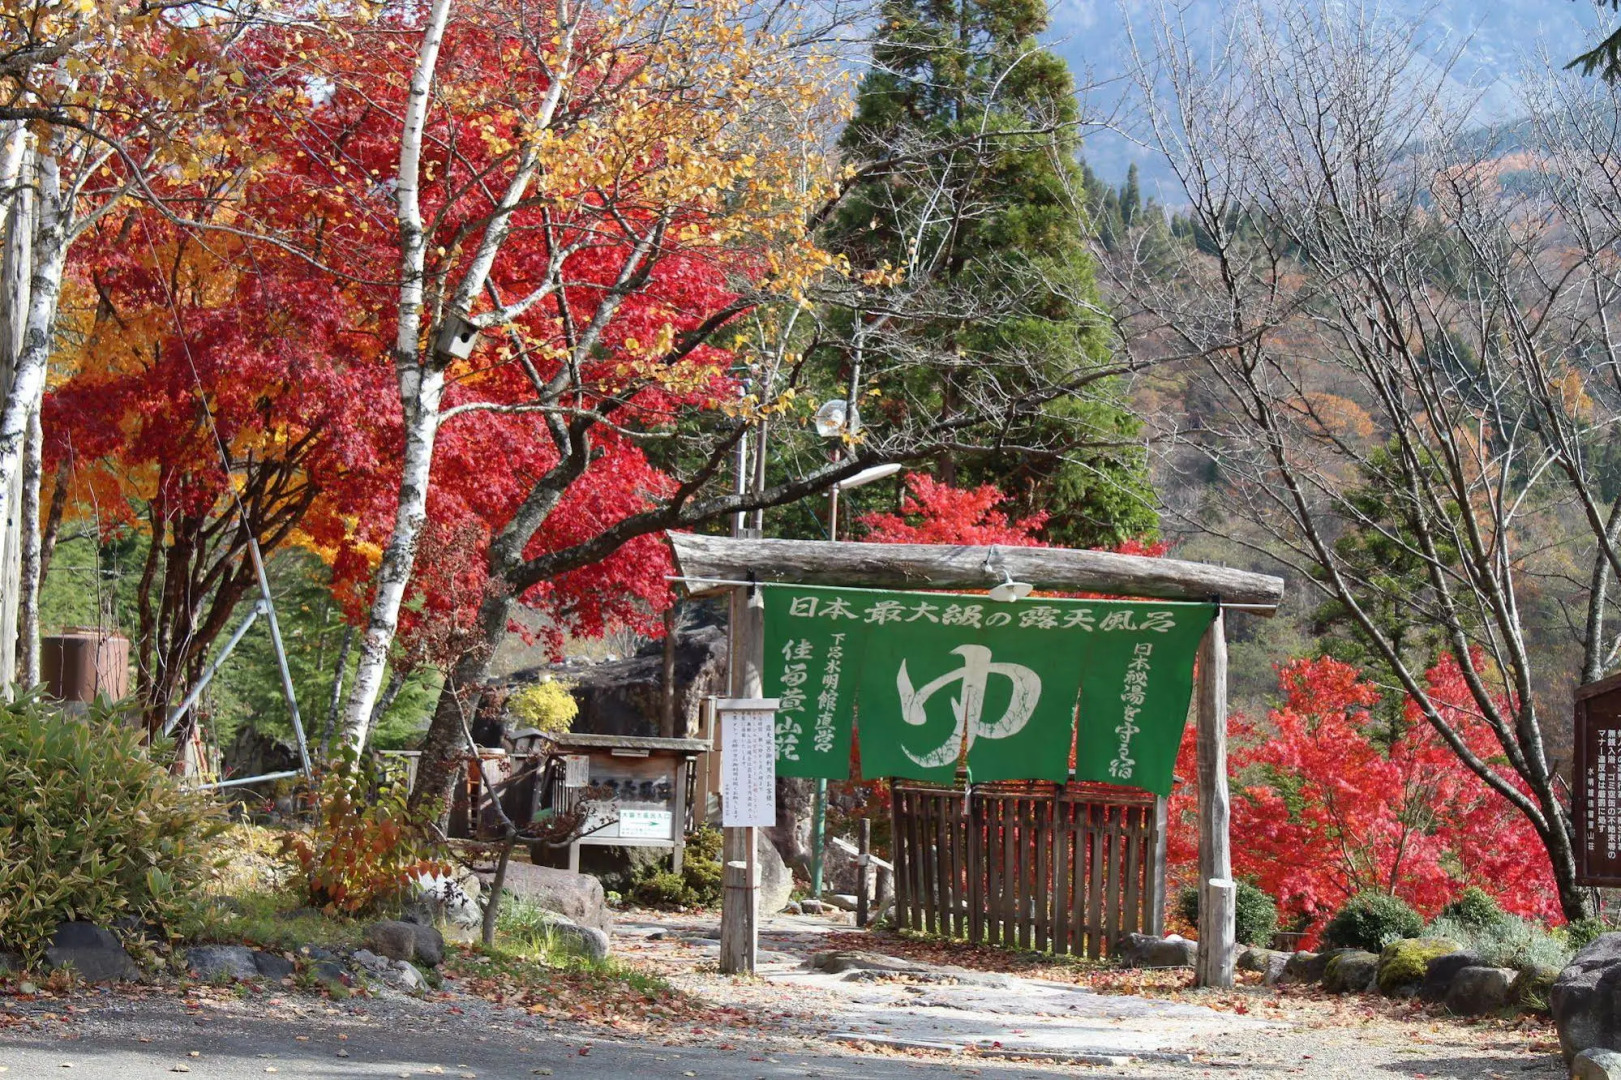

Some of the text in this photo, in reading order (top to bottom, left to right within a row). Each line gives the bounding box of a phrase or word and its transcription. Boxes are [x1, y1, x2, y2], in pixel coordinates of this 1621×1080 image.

[789, 596, 1177, 633] 日本最大級の露天風呂
[775, 638, 814, 761] 佳留萱山荘
[813, 633, 847, 753] 下呂水明館直営
[896, 644, 1042, 768] ゆ
[1108, 642, 1153, 780] 日本秘湯を守る宿
[1597, 730, 1606, 833] マナー違反者は厳罰に処す
